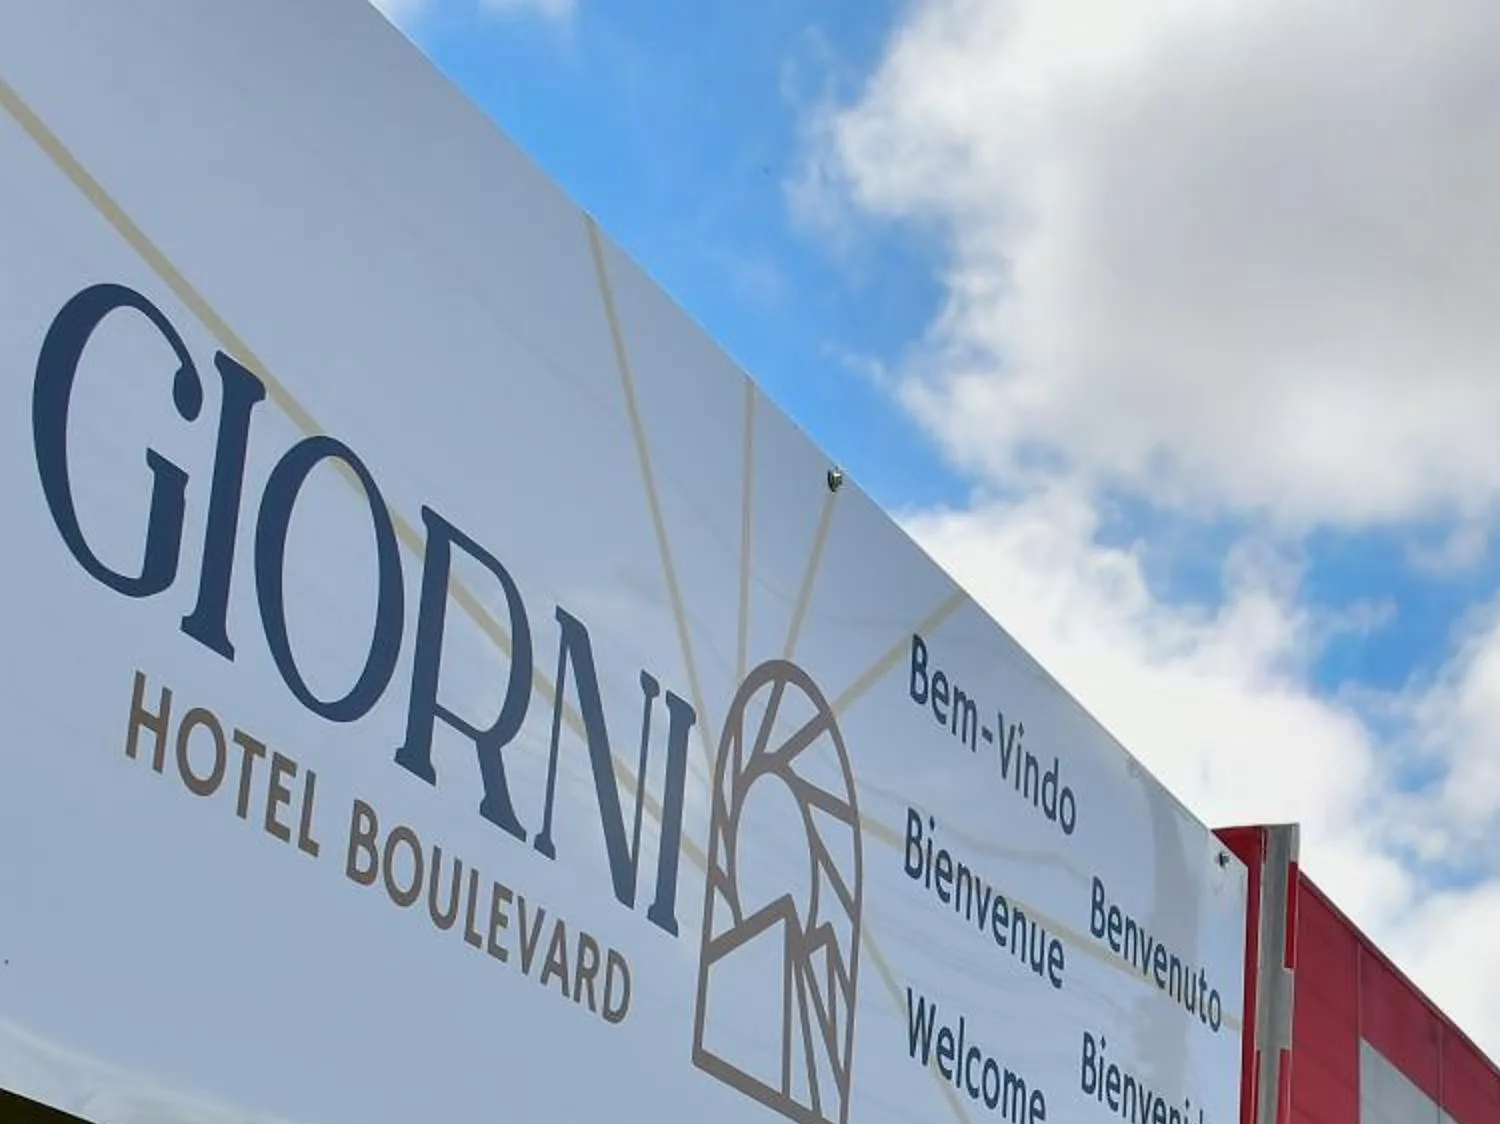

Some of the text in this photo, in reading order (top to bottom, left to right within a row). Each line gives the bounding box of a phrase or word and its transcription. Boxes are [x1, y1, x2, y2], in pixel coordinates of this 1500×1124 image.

[31, 282, 697, 938] GIORNI
[909, 633, 1077, 836] Bem-Vindo
[125, 669, 632, 1026] HOTEL BOULEVARD
[903, 806, 1066, 989] Bienvenue
[1089, 875, 1222, 1034] Benvenuto
